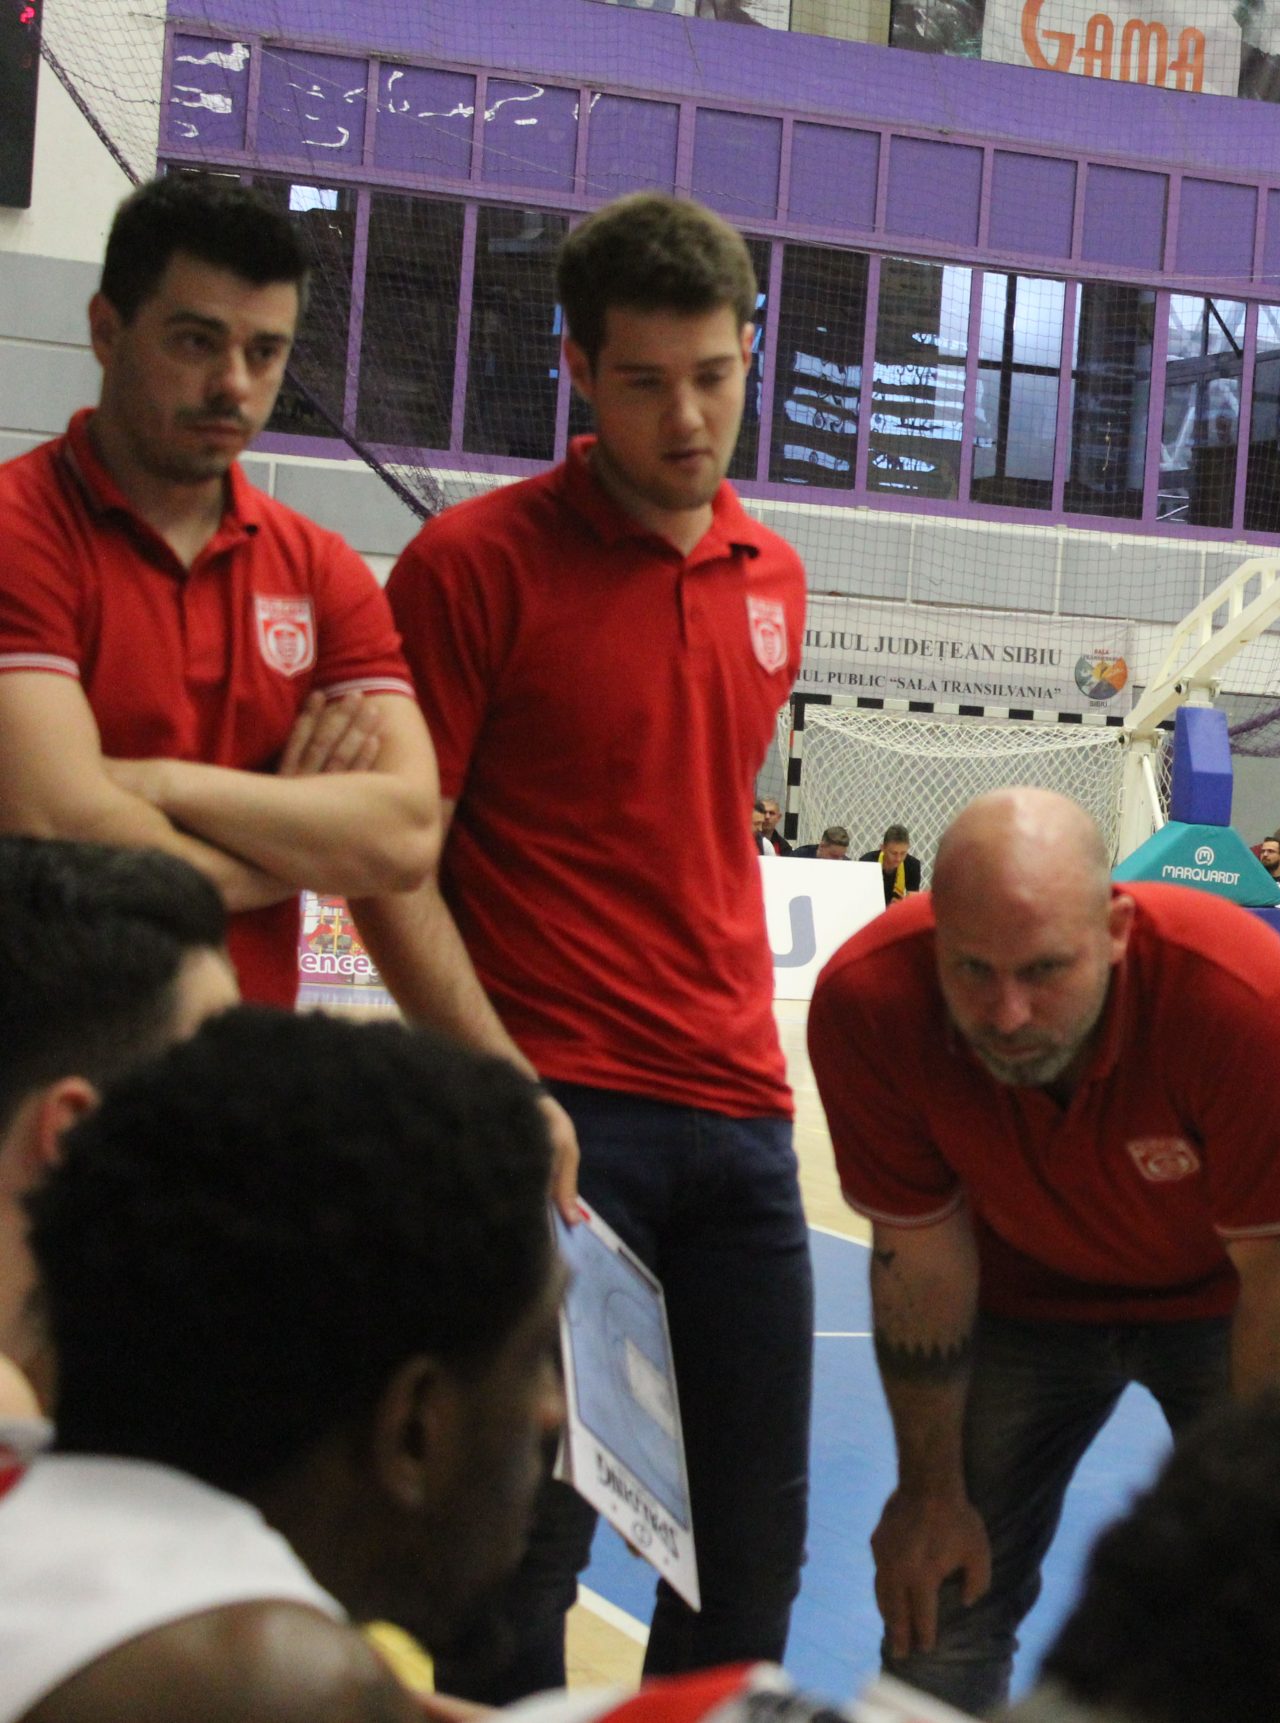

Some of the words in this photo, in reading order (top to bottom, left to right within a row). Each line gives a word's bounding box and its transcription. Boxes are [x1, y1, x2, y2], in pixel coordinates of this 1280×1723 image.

[1021, 0, 1206, 93] GAMA
[1002, 645, 1062, 666] SIBIU
[827, 671, 886, 688] PUBLIC
[1162, 865, 1240, 885] MARQUARDT
